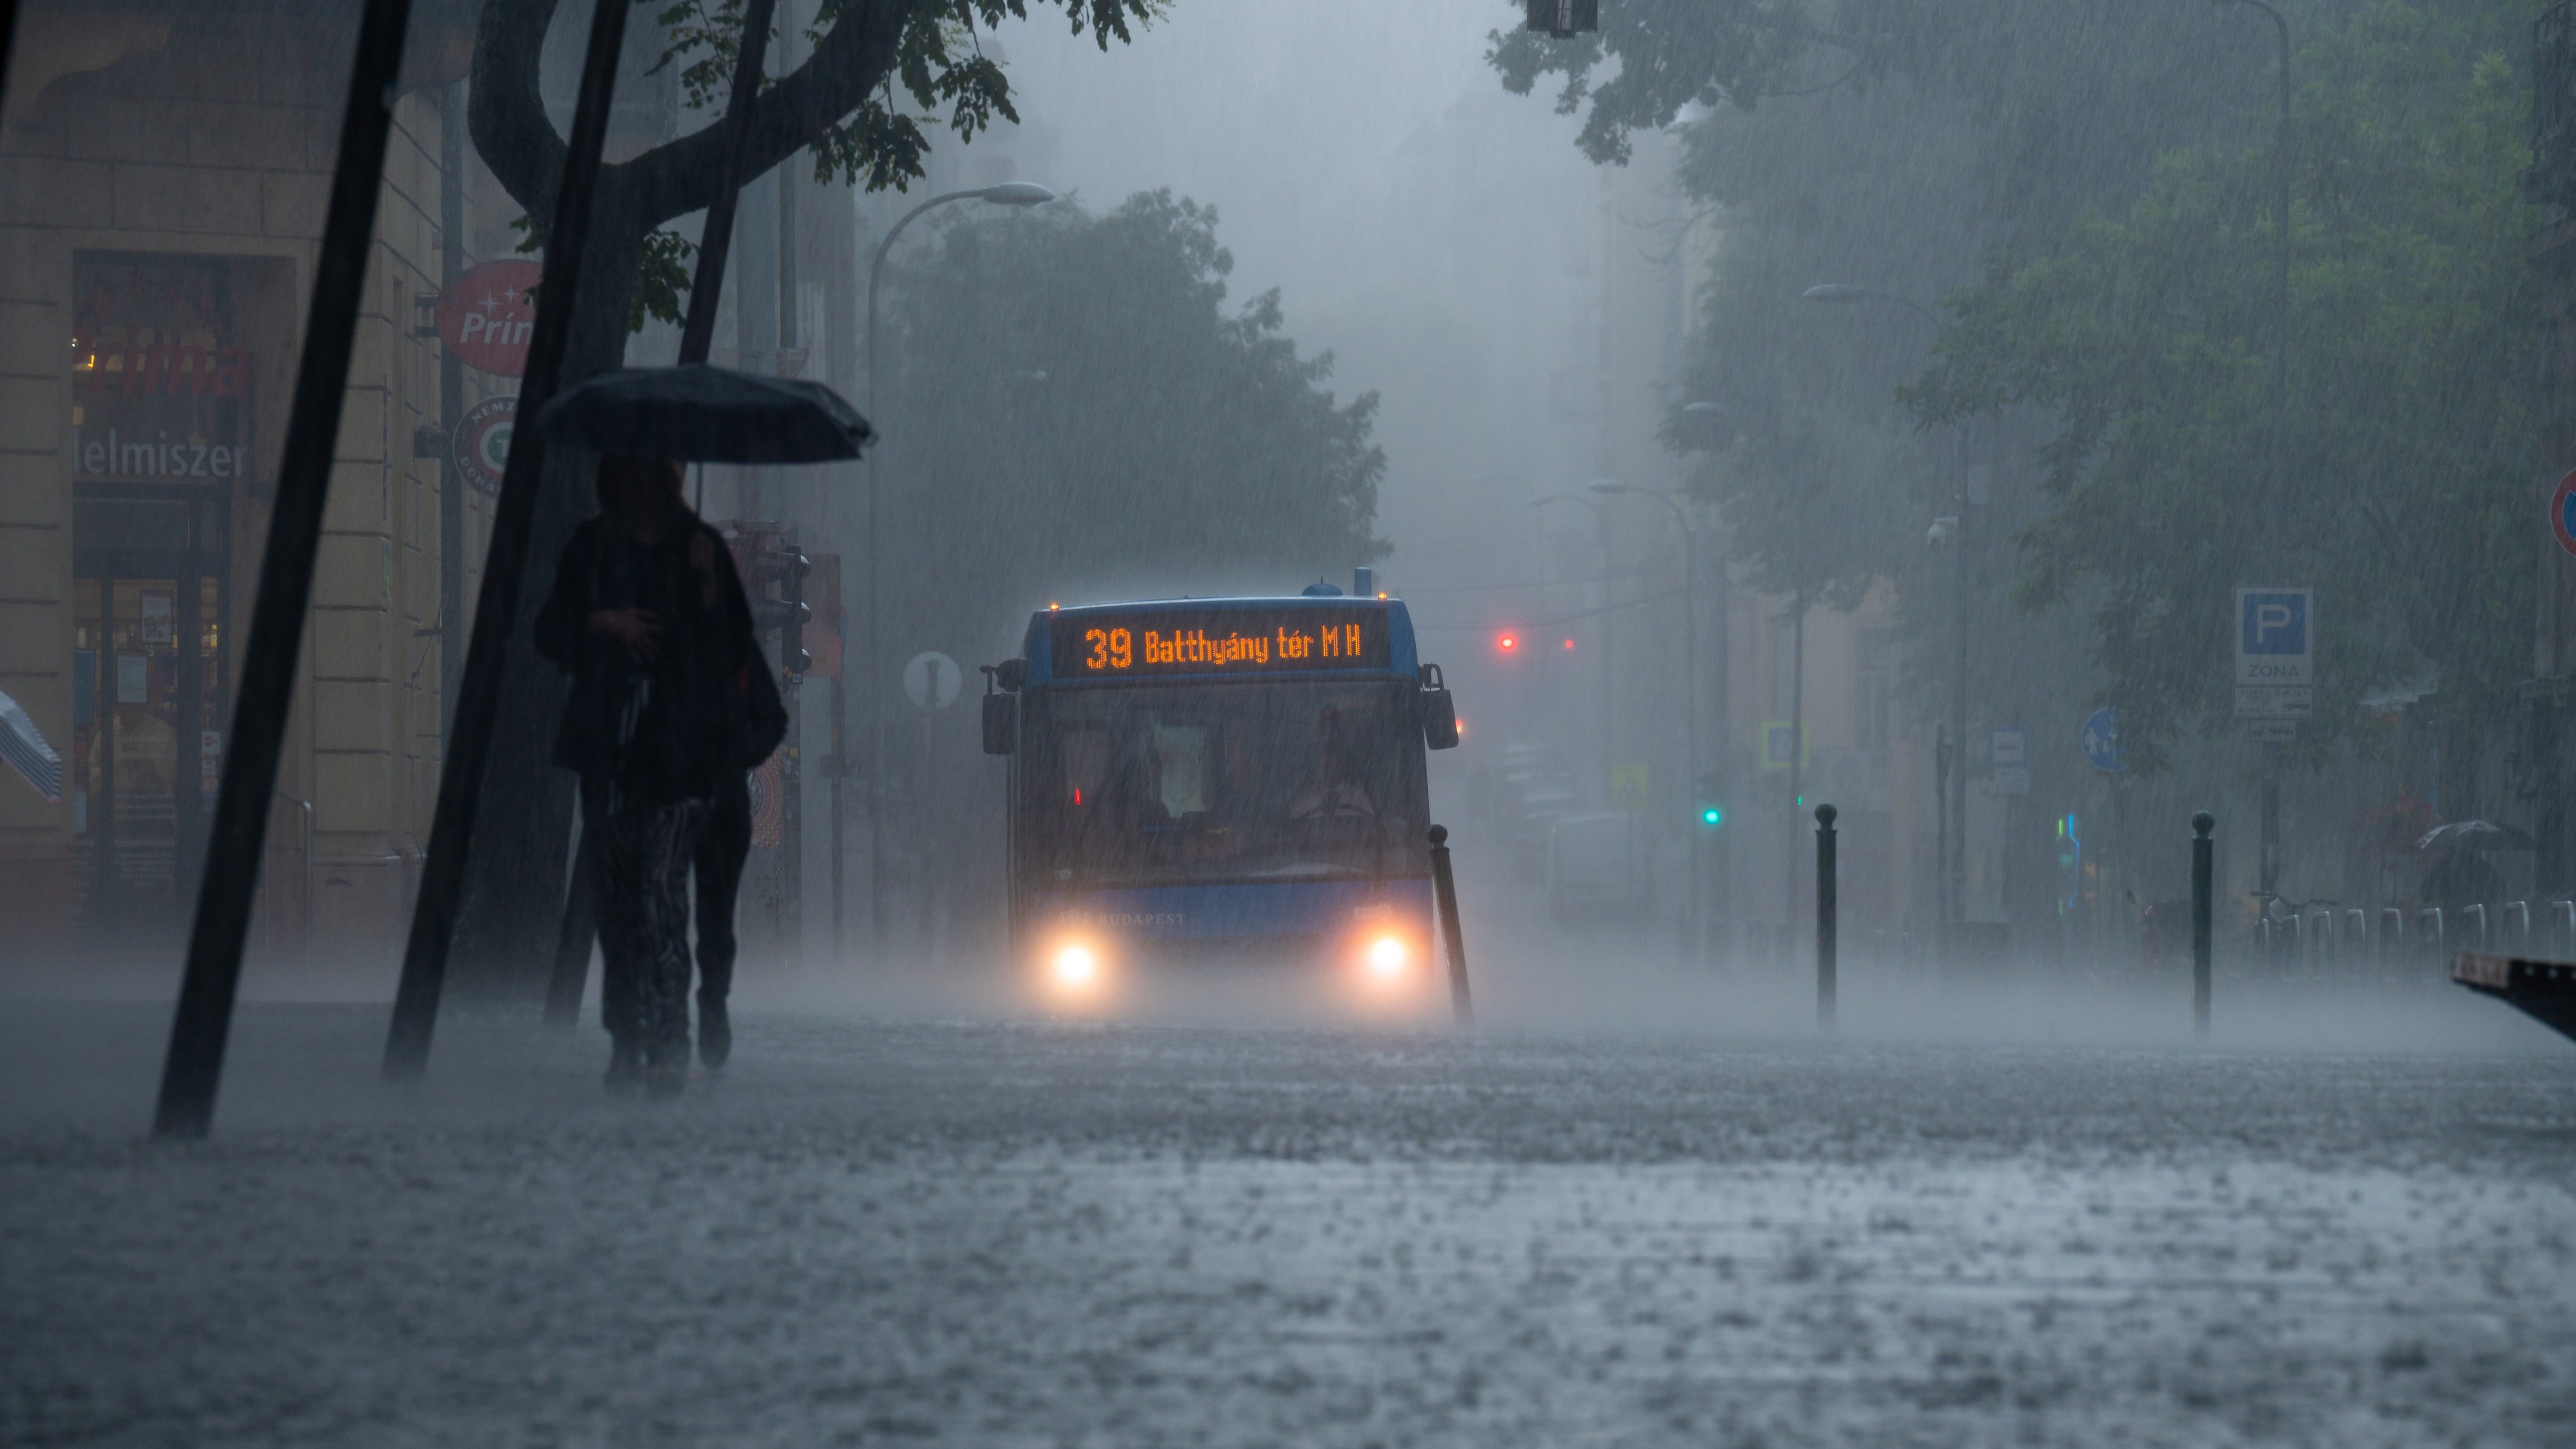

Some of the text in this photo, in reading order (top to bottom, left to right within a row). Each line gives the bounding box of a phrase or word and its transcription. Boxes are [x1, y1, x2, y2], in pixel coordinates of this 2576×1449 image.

[2256, 604, 2292, 645] P
[1085, 624, 1361, 669] 39 Batthyány tér M H
[1098, 914, 1186, 925] BUDAPEST
